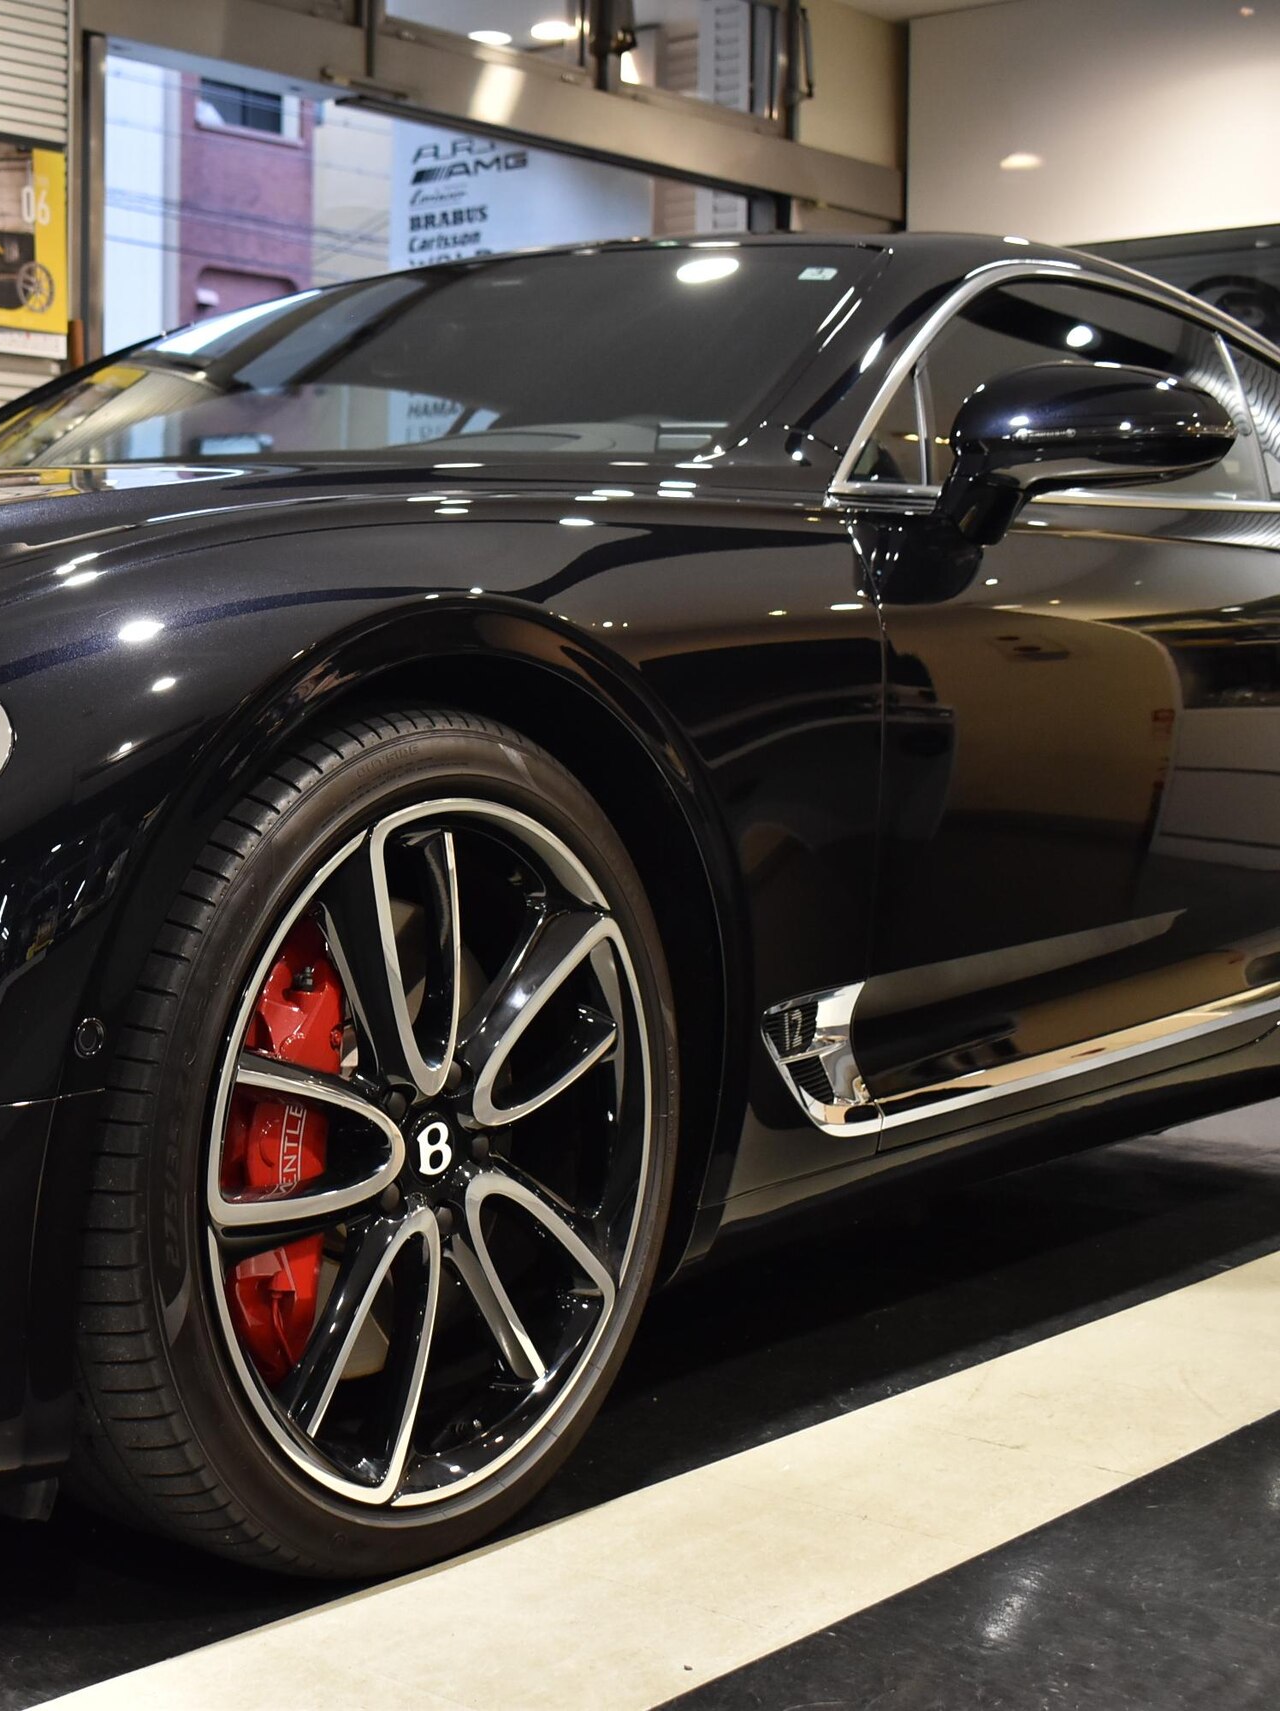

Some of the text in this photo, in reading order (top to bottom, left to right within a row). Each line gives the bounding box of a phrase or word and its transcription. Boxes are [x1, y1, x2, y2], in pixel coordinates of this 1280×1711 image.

[444, 151, 528, 179] AMG
[22, 184, 51, 226] 06
[409, 205, 488, 232] BRABUS
[280, 1103, 305, 1182] ENTLE
[416, 1121, 453, 1176] B
